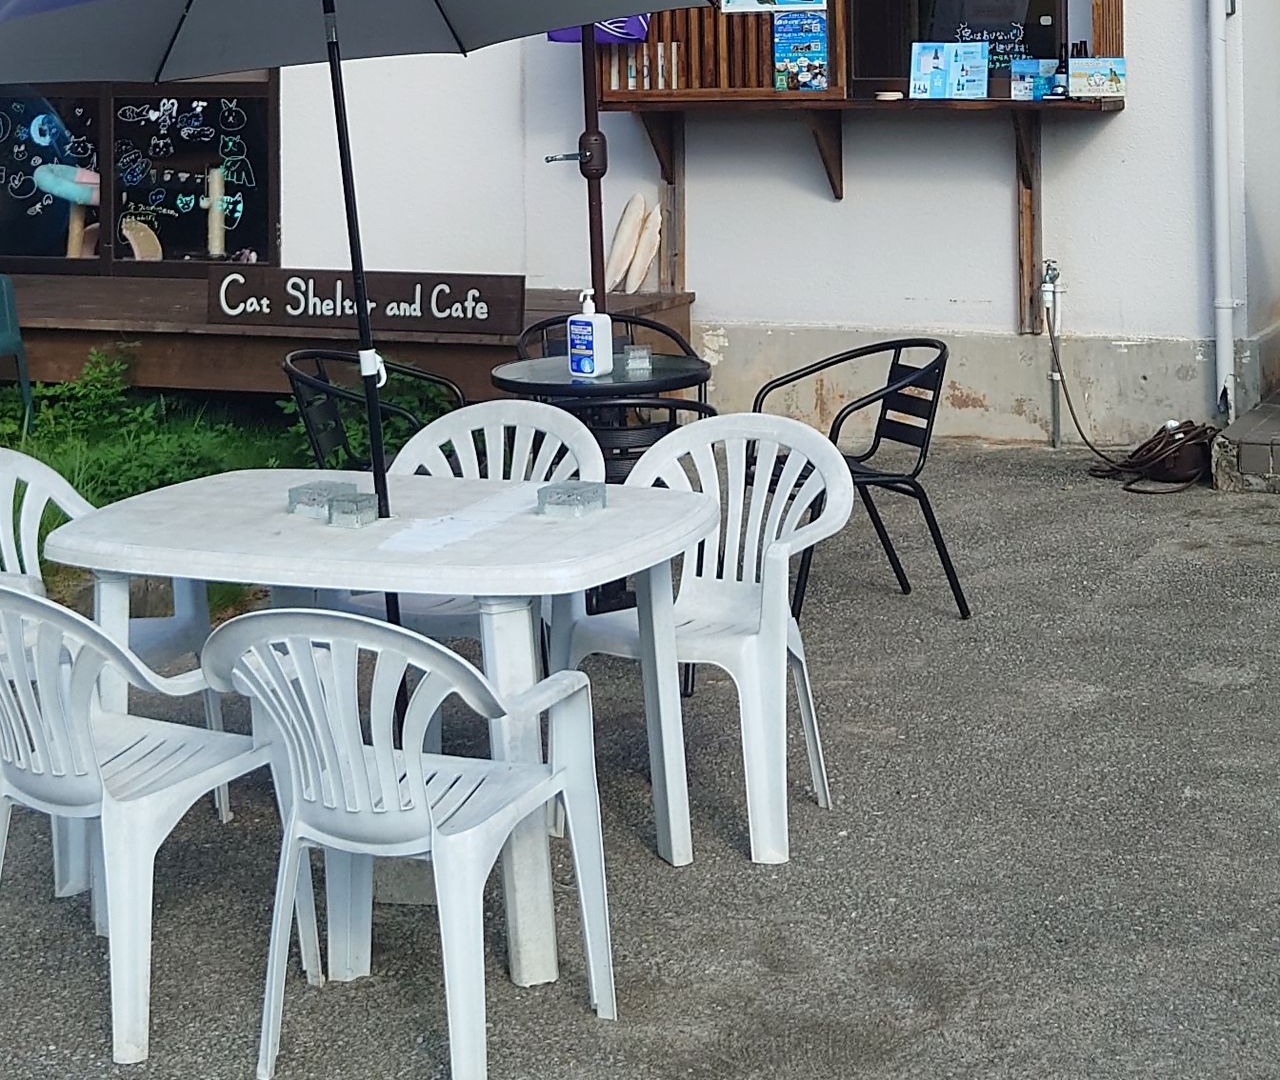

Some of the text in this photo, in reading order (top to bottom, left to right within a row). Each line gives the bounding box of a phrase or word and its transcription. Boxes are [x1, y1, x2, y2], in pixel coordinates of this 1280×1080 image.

[220, 273, 490, 320] Cat Sheltr and Cafe
